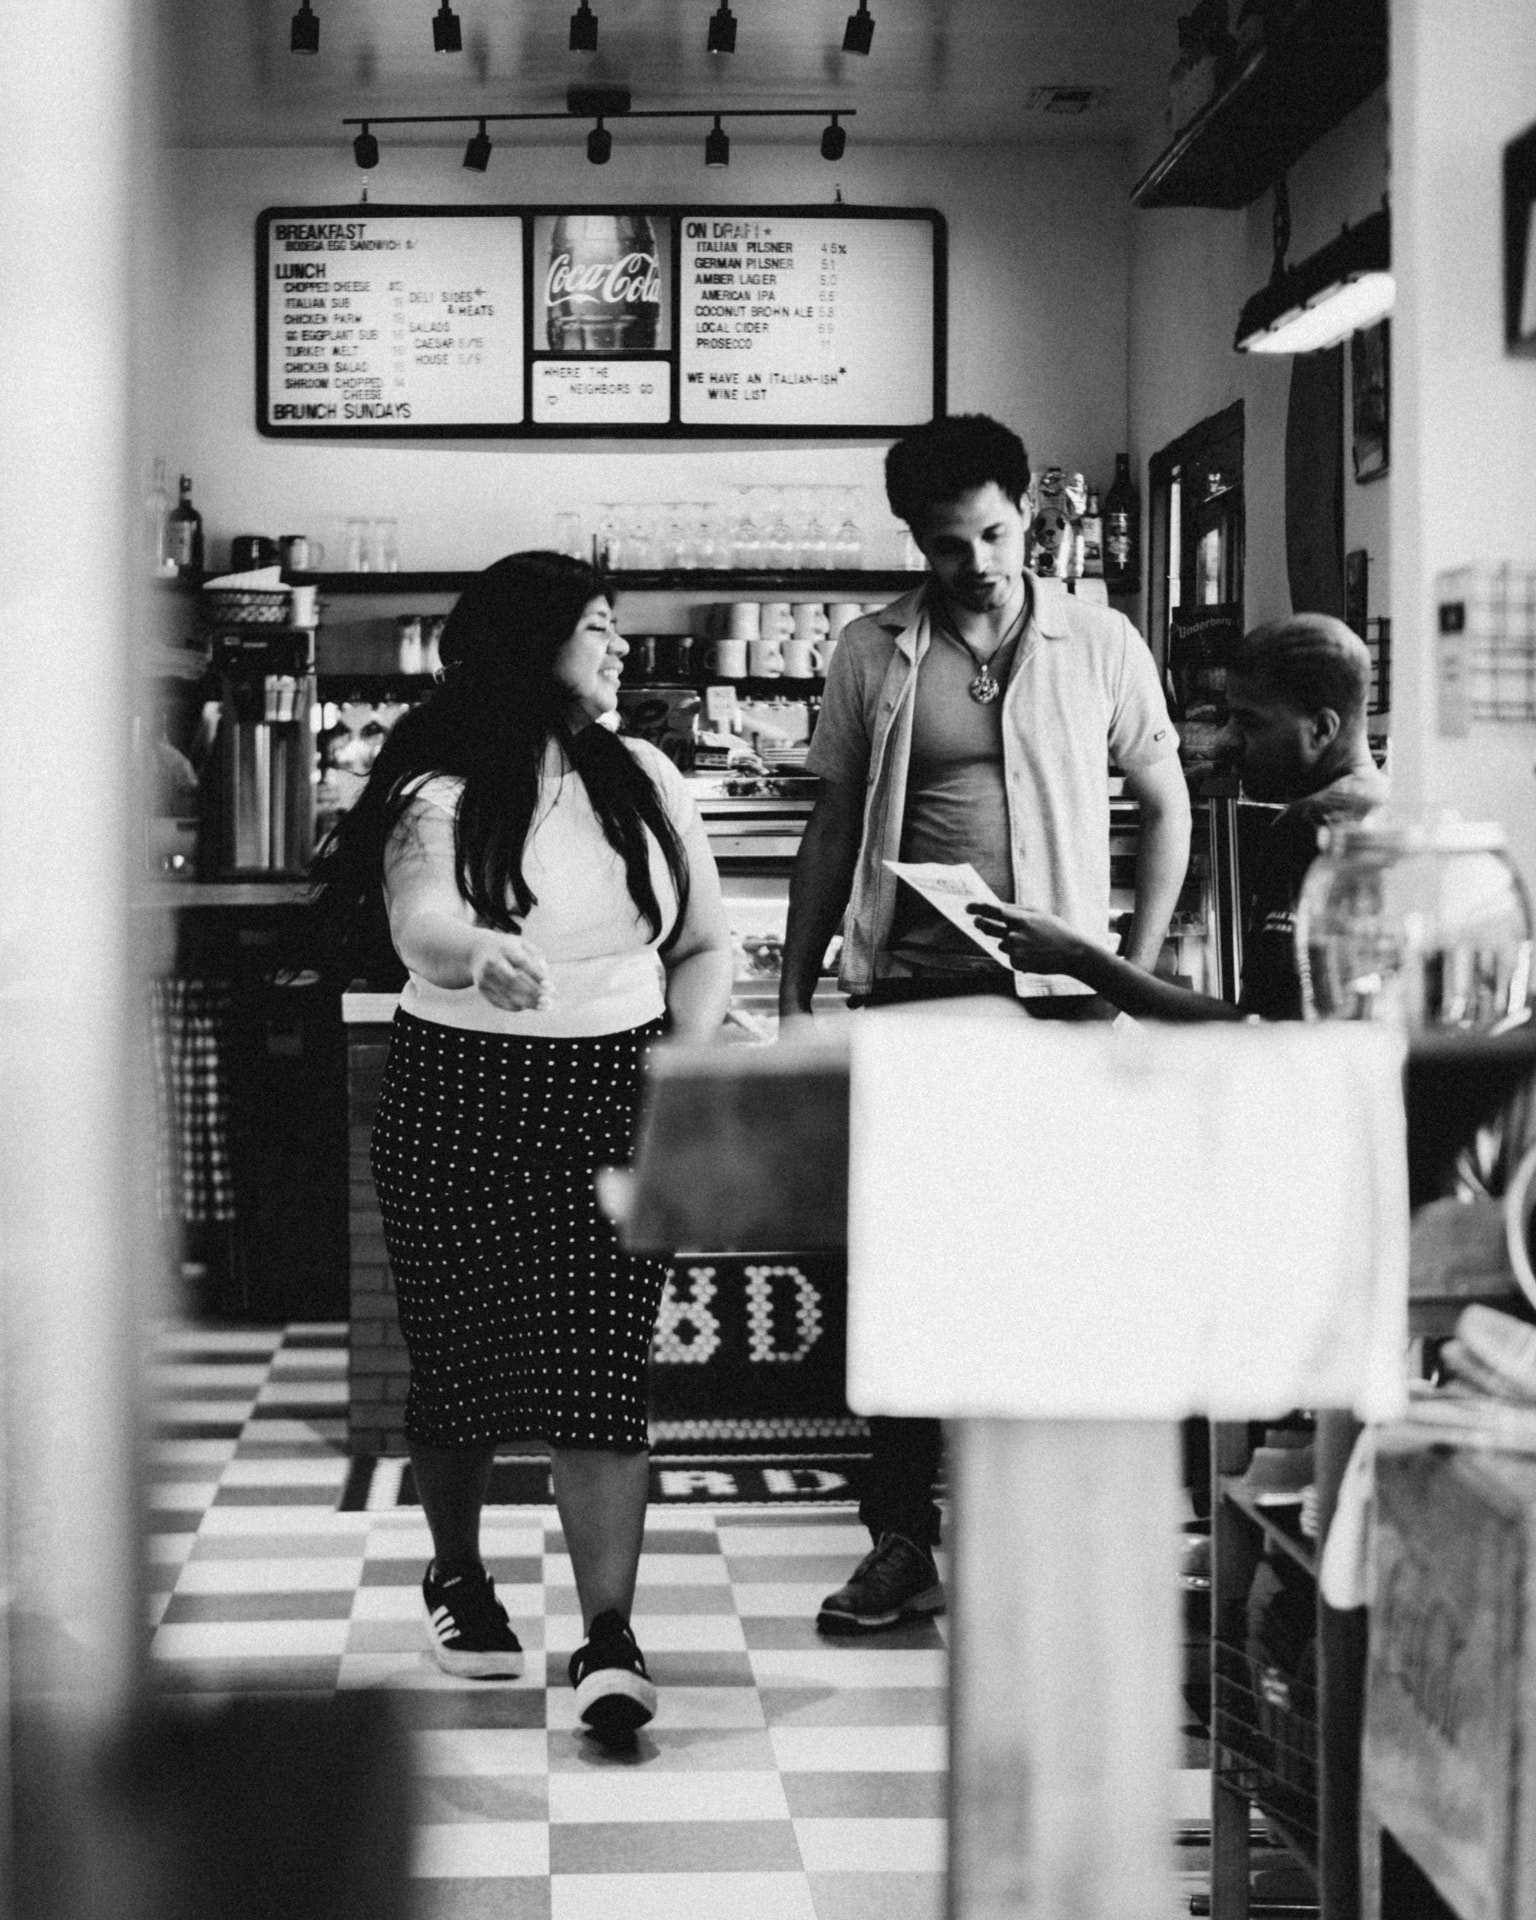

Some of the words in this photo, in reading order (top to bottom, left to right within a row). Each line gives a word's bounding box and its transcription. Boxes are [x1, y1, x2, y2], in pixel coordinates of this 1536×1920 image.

[275, 223, 366, 240] BREAKFAST
[687, 222, 706, 239] ON
[714, 222, 759, 239] DRAFT
[285, 240, 324, 252] BODEGA
[327, 240, 347, 251] EGG
[349, 240, 400, 251] SANDWICH
[697, 242, 737, 253] ITALIAN
[746, 242, 793, 253] PILSNER
[694, 258, 741, 269] GERMAN
[746, 258, 793, 269] PILSNER
[275, 263, 326, 279] LUNCH
[546, 253, 660, 306] Coca-Cola
[695, 274, 734, 285] AMBER
[739, 274, 776, 285] LAGER
[284, 281, 329, 293] CHOPPED
[333, 281, 371, 292] CHEESE
[442, 291, 473, 303] SIDES
[701, 290, 750, 301] AMERICAN
[758, 290, 776, 301] IPA
[286, 297, 326, 309] ITALIAN
[331, 297, 350, 309] SUB
[459, 304, 494, 316] MEATS
[694, 305, 745, 317] COCONUT
[751, 306, 789, 317] BROWN
[794, 306, 813, 318] ALE
[284, 313, 328, 324] CHICKEN
[408, 321, 450, 332] SALADS
[696, 322, 730, 333] LOCAL
[735, 322, 769, 333] CIDER
[301, 329, 354, 341] EGGPLANT
[415, 337, 454, 349] CAESAR
[696, 338, 752, 349] PROSECCO
[285, 345, 325, 357] TURKEY
[332, 345, 359, 356] MELT
[415, 353, 449, 365] HOUSE
[284, 362, 329, 373] CHICKEN
[334, 361, 368, 373] SALAD
[544, 367, 580, 378] WHERE
[589, 366, 608, 378] THE
[285, 378, 329, 389] SHROOM
[335, 377, 383, 388] CHOPPED
[687, 372, 704, 383] WE
[709, 372, 739, 384] HAVE
[747, 373, 761, 383] AN
[769, 372, 838, 384] ITALIAN-ISH
[343, 389, 383, 400] CHEESE
[570, 383, 630, 394] NEIGHBORS
[641, 383, 654, 394] GO
[708, 388, 738, 400] WINE
[744, 388, 767, 400] LIST
[273, 402, 337, 420] BRUNCH
[344, 402, 411, 419] SUNDAYS
